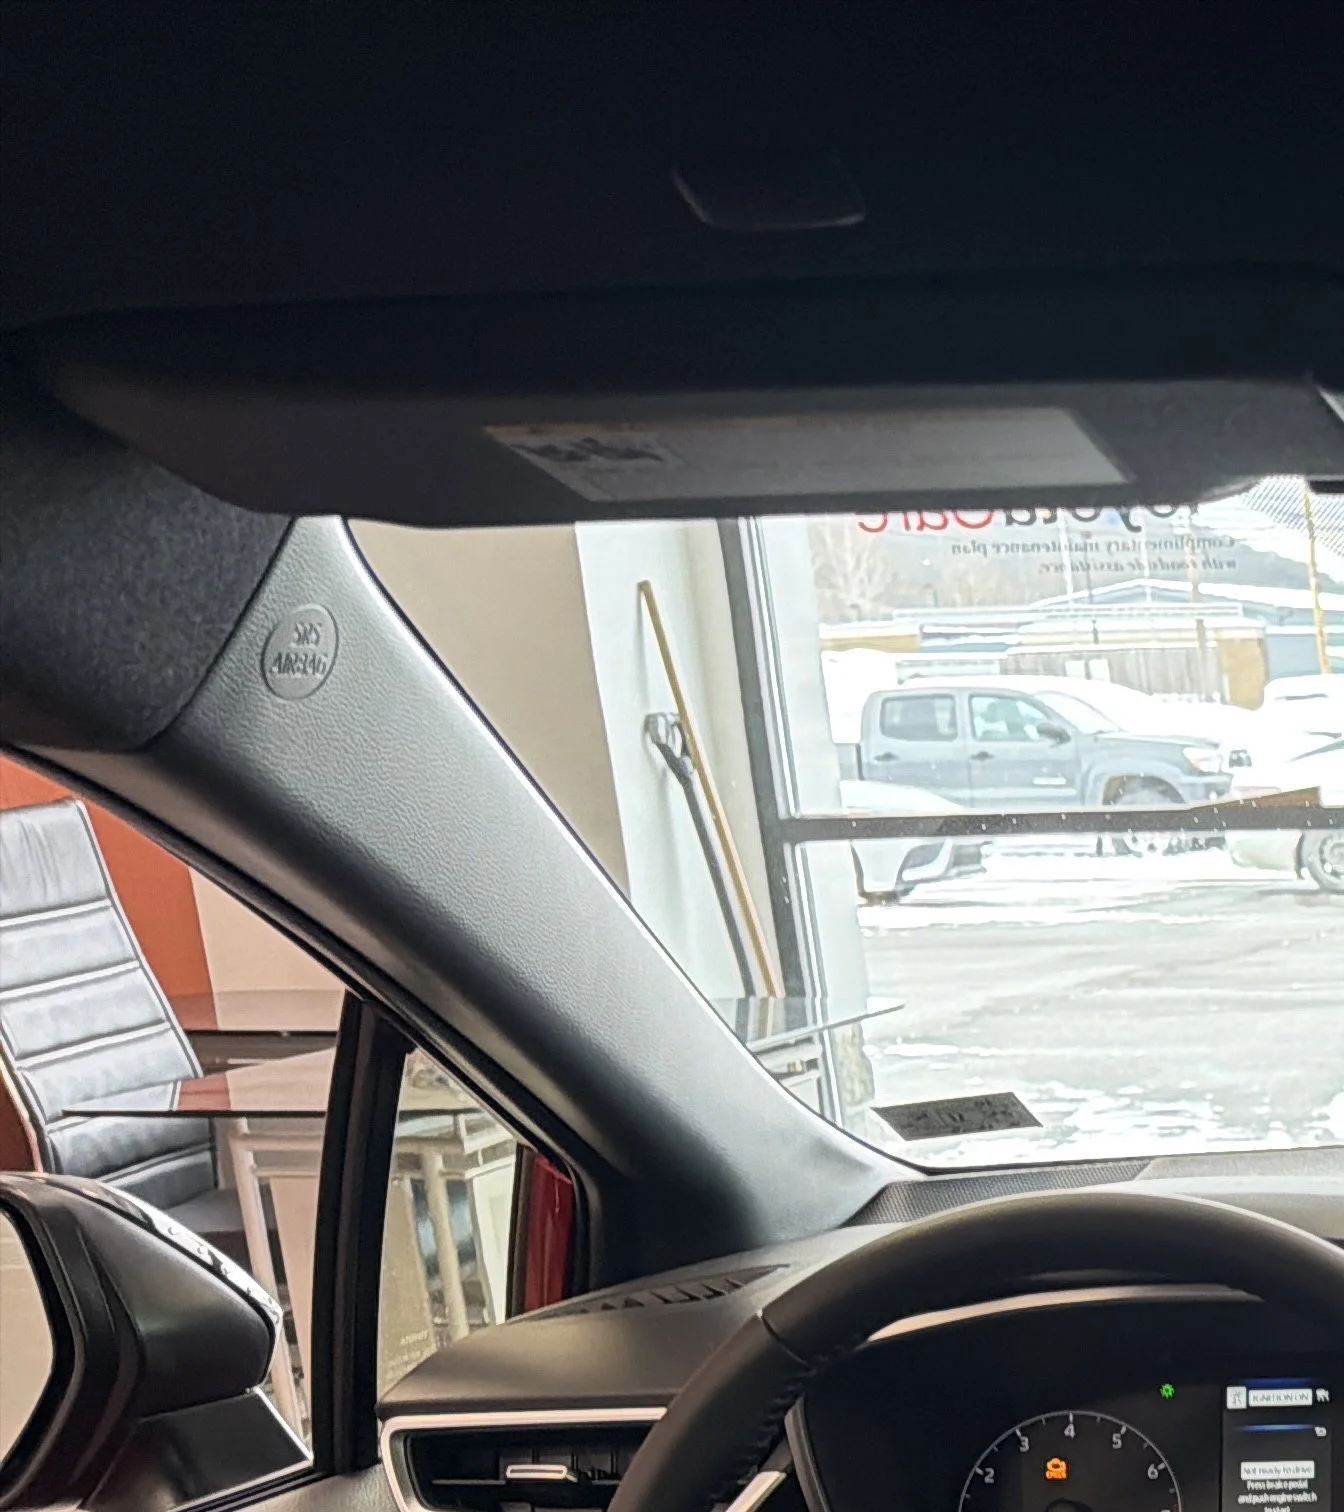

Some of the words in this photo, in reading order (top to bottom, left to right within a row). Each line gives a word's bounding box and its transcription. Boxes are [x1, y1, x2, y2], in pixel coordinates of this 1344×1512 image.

[1064, 1424, 1075, 1439] 4
[1019, 1436, 1030, 1451] 3
[1112, 1433, 1122, 1449] 5
[984, 1467, 995, 1484] 2
[1147, 1463, 1159, 1480] 6
